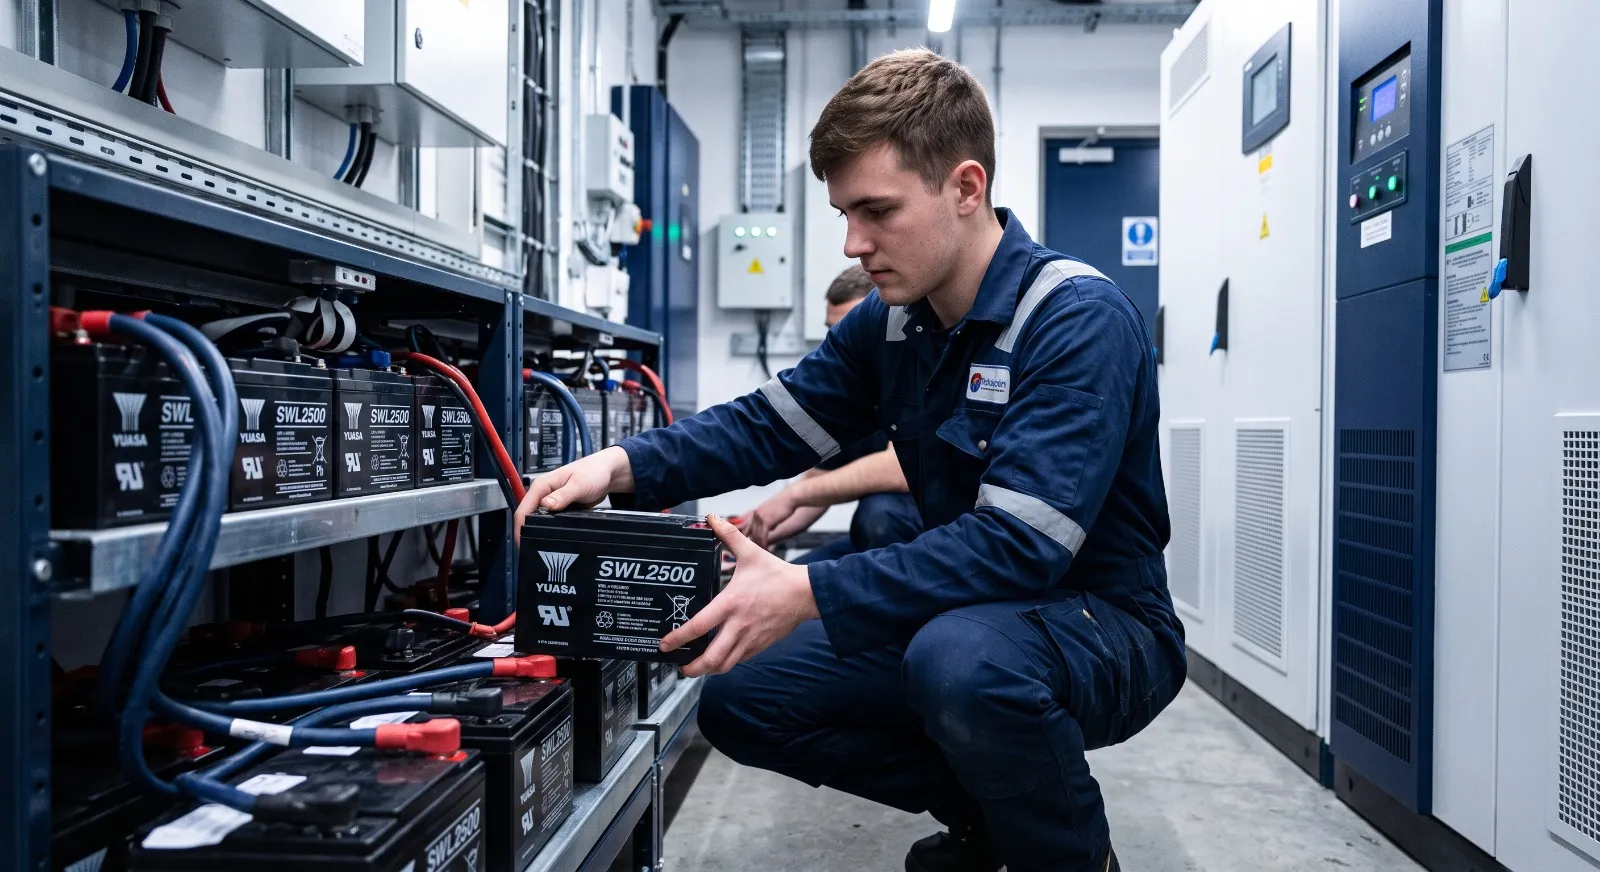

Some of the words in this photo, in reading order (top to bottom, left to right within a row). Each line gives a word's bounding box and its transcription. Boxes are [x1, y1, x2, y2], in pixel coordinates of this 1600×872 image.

[276, 406, 326, 423] SWL2500
[371, 409, 409, 423] SWL2500
[112, 434, 148, 447] YUASA
[240, 433, 266, 443] YUASA
[344, 432, 363, 440] YUASA
[599, 560, 695, 583] SWL2500
[536, 583, 576, 595] YUASA
[427, 806, 480, 872] SWL2500
